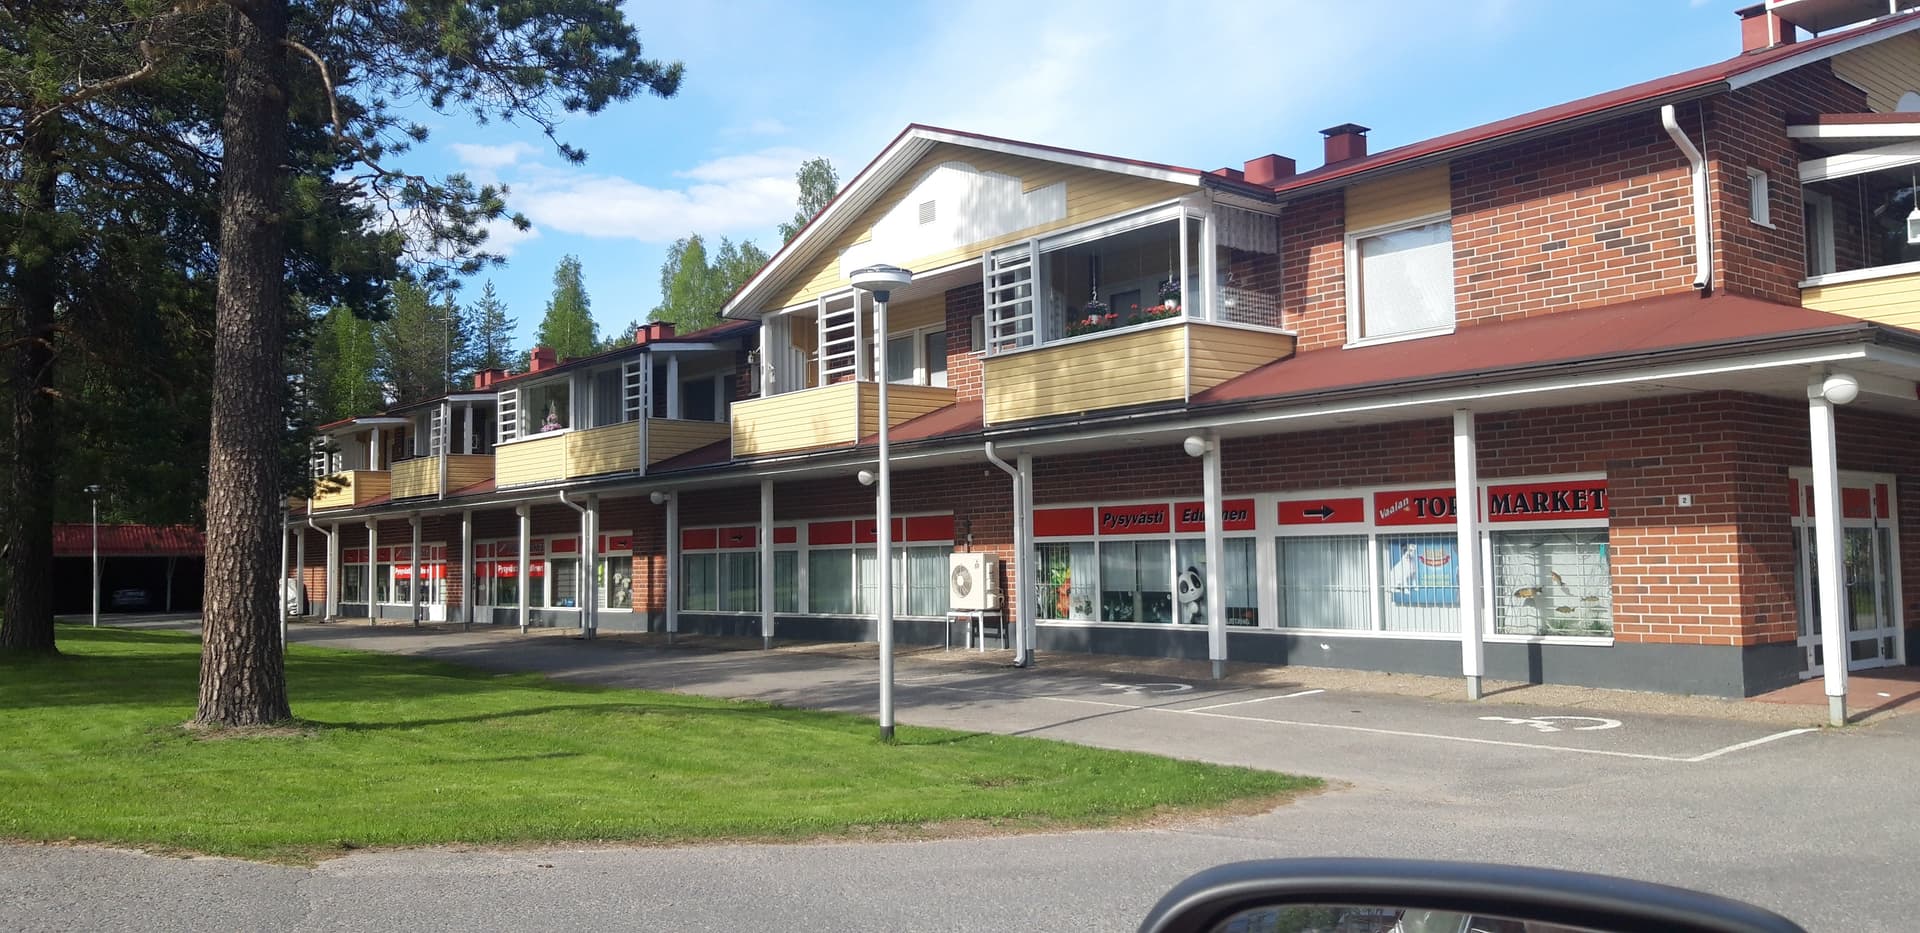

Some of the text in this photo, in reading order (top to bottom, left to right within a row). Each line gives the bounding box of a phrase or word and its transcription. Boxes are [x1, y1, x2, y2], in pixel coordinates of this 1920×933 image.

[1380, 498, 1409, 519] Vaalan
[1490, 488, 1608, 515] MARKET
[1104, 511, 1164, 529] Pysyvästi
